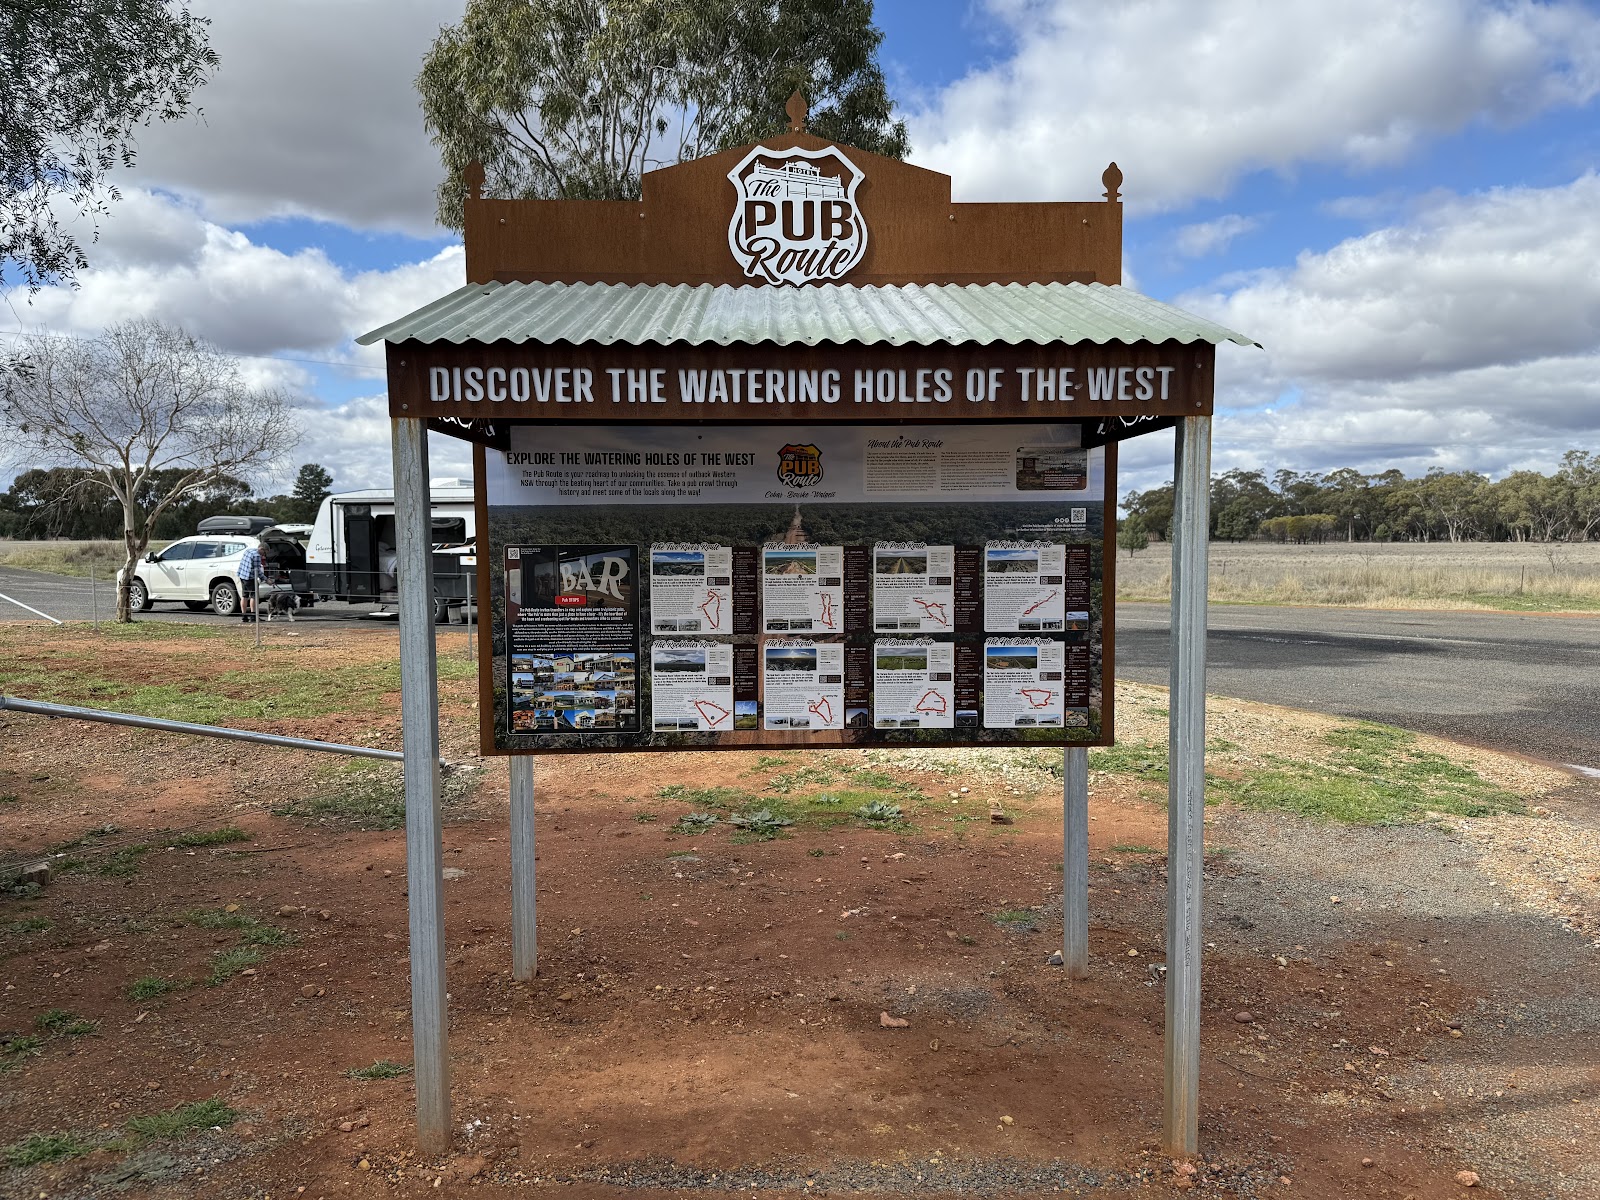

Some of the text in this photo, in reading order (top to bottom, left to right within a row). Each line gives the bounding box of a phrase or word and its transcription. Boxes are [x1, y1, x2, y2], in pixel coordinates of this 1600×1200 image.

[793, 167, 815, 176] HOTEL
[749, 179, 782, 198] The
[745, 201, 854, 241] PUB
[746, 237, 852, 283] Route
[429, 366, 1175, 403] DISCOVER THE WATERING HOLES OF THE WEST
[867, 439, 944, 449] About the Pub Route
[506, 452, 756, 465] EXPLORE THE WATERING HOLES OF THE WEST
[781, 460, 820, 475] PUB
[522, 470, 532, 478] The
[533, 470, 544, 478] Pub
[545, 470, 563, 478] Route
[564, 470, 569, 478] is
[585, 470, 610, 479] roadmap
[611, 470, 617, 478] to
[646, 470, 656, 478] the
[681, 470, 687, 478] of
[688, 470, 711, 478] outback
[712, 470, 736, 478] Western
[535, 480, 558, 488] through
[570, 480, 591, 488] beating
[687, 480, 697, 488] pub
[716, 480, 738, 488] through
[782, 472, 820, 488] Route
[559, 489, 579, 497] history
[661, 489, 676, 497] along
[764, 490, 783, 499] Cobar
[652, 542, 665, 550] The
[701, 542, 720, 551] Route
[799, 543, 820, 551] Route
[876, 542, 888, 550] The
[906, 542, 927, 550] Route
[986, 541, 999, 549] The
[1033, 541, 1054, 549] Route
[560, 556, 630, 600] BAR
[653, 640, 666, 649] The
[699, 640, 719, 649] Route
[766, 639, 778, 647] The
[794, 639, 814, 647] Route
[876, 639, 888, 647] The
[915, 639, 935, 647] Route
[986, 638, 999, 646] The
[1033, 638, 1053, 646] Route
